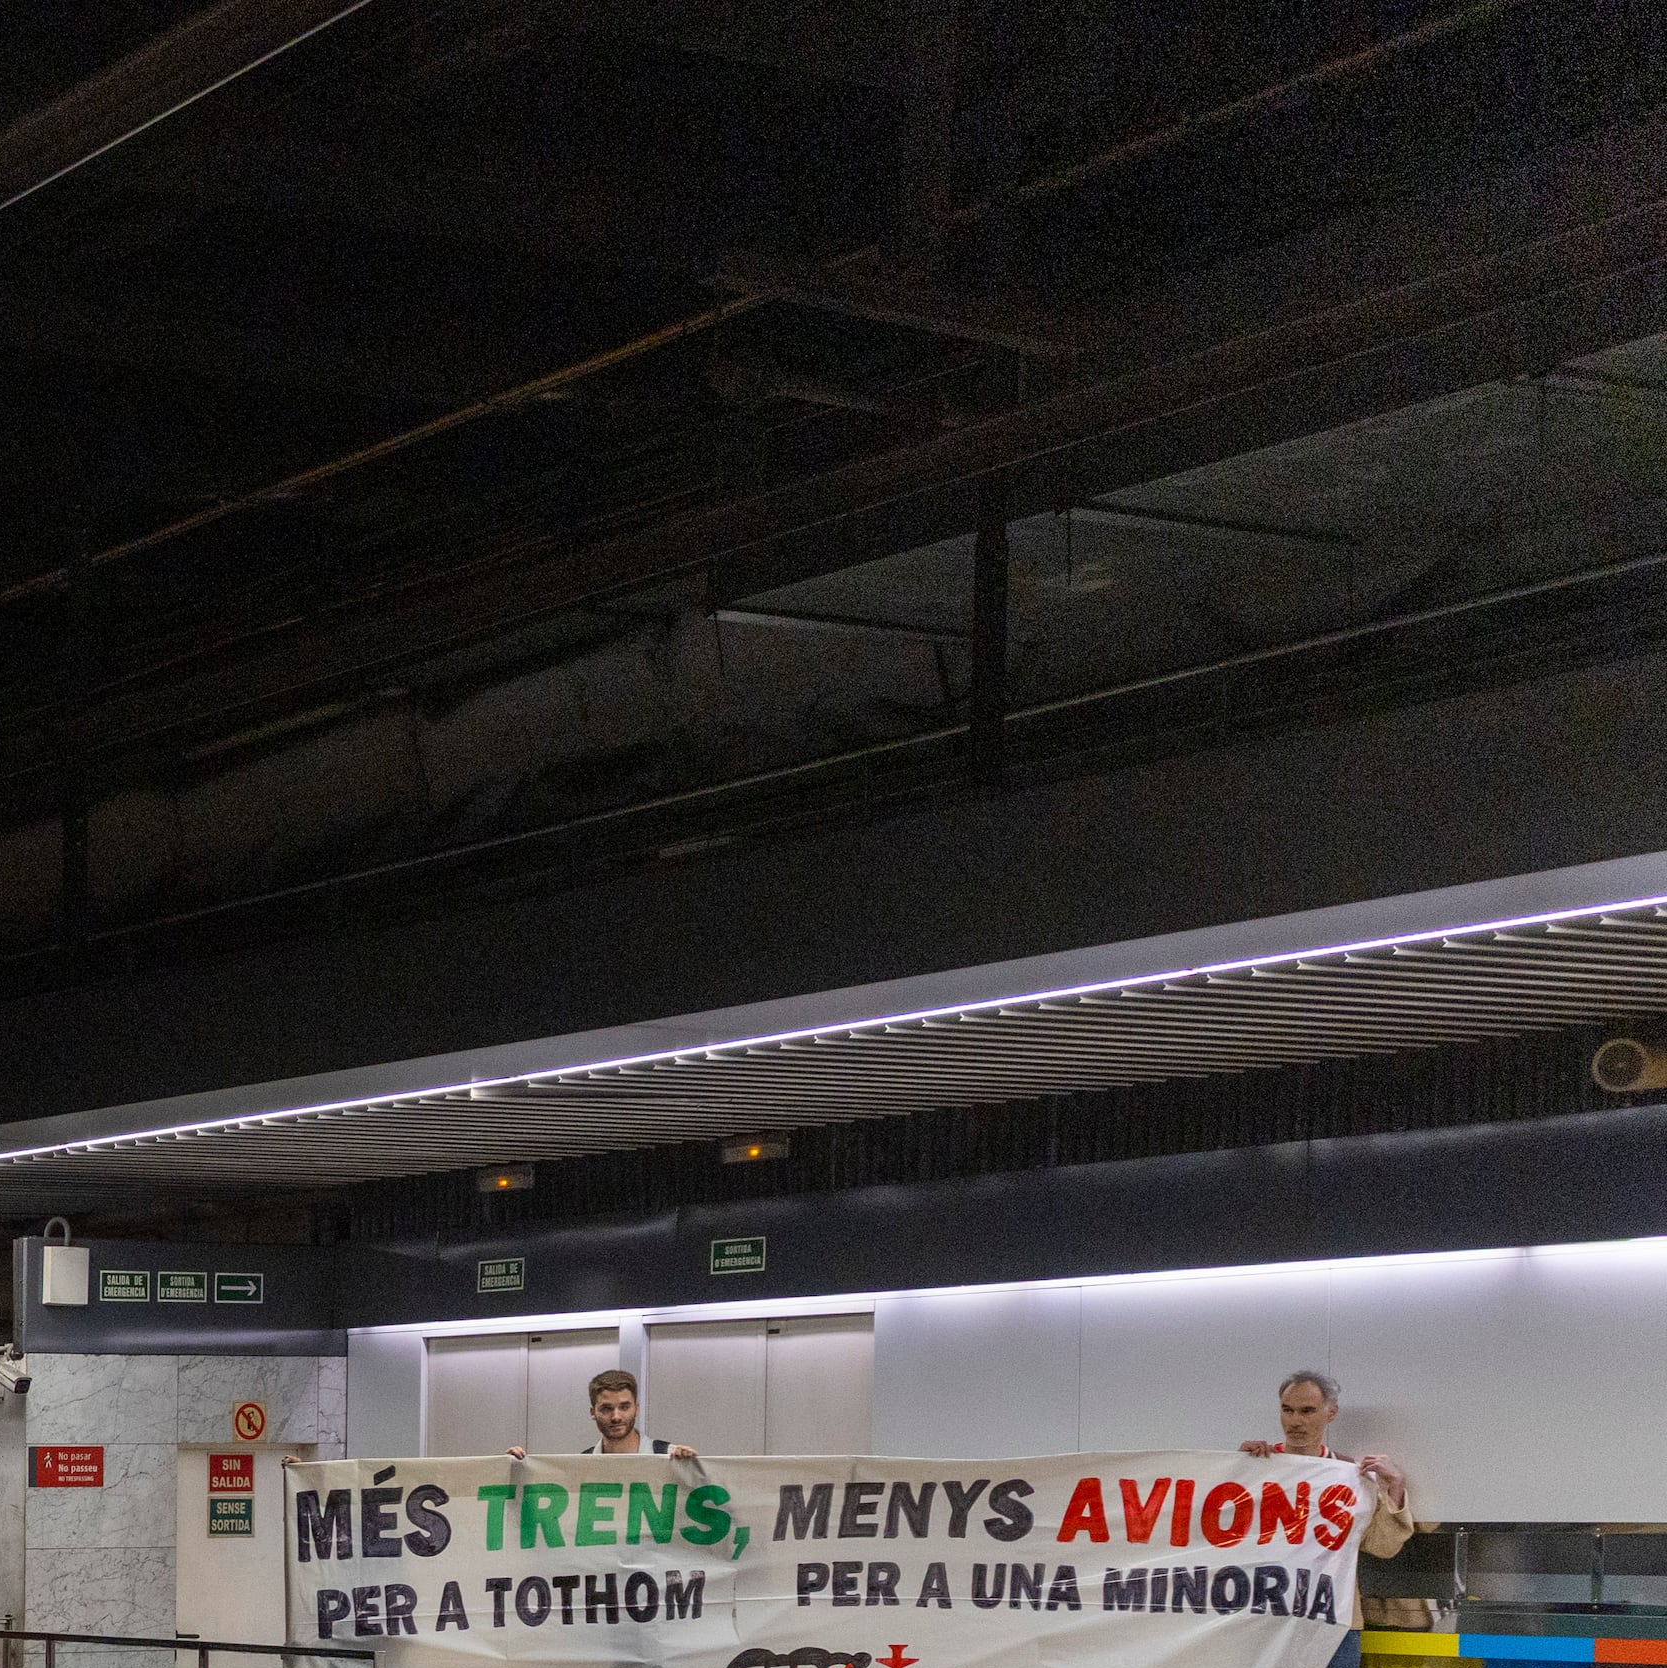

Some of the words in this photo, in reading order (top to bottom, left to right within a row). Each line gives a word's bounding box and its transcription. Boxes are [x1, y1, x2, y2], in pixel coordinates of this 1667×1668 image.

[106, 1275, 131, 1285] SALIDA
[133, 1275, 144, 1286] DE
[169, 1276, 196, 1286] SORTIDA
[103, 1287, 146, 1297] EMERGENCIA
[58, 1452, 69, 1460] No
[70, 1453, 92, 1463] pasar
[58, 1463, 69, 1472] No
[70, 1464, 98, 1474] passeu
[222, 1459, 241, 1471] SIN
[211, 1476, 251, 1488] SALIDA
[216, 1502, 246, 1514] SENSE
[295, 1465, 453, 1563] MÉS
[476, 1481, 752, 1561] TRENS,
[772, 1478, 1035, 1543] MENYS
[1055, 1477, 1358, 1552] AVIONS
[211, 1519, 250, 1531] SORTIDA
[796, 1561, 901, 1608] PER
[916, 1561, 953, 1609] A
[971, 1561, 1083, 1612] UNA
[1101, 1565, 1338, 1626] MINORIA
[316, 1583, 419, 1640] PER
[435, 1580, 470, 1632] A
[485, 1570, 707, 1628] TOTHOM
